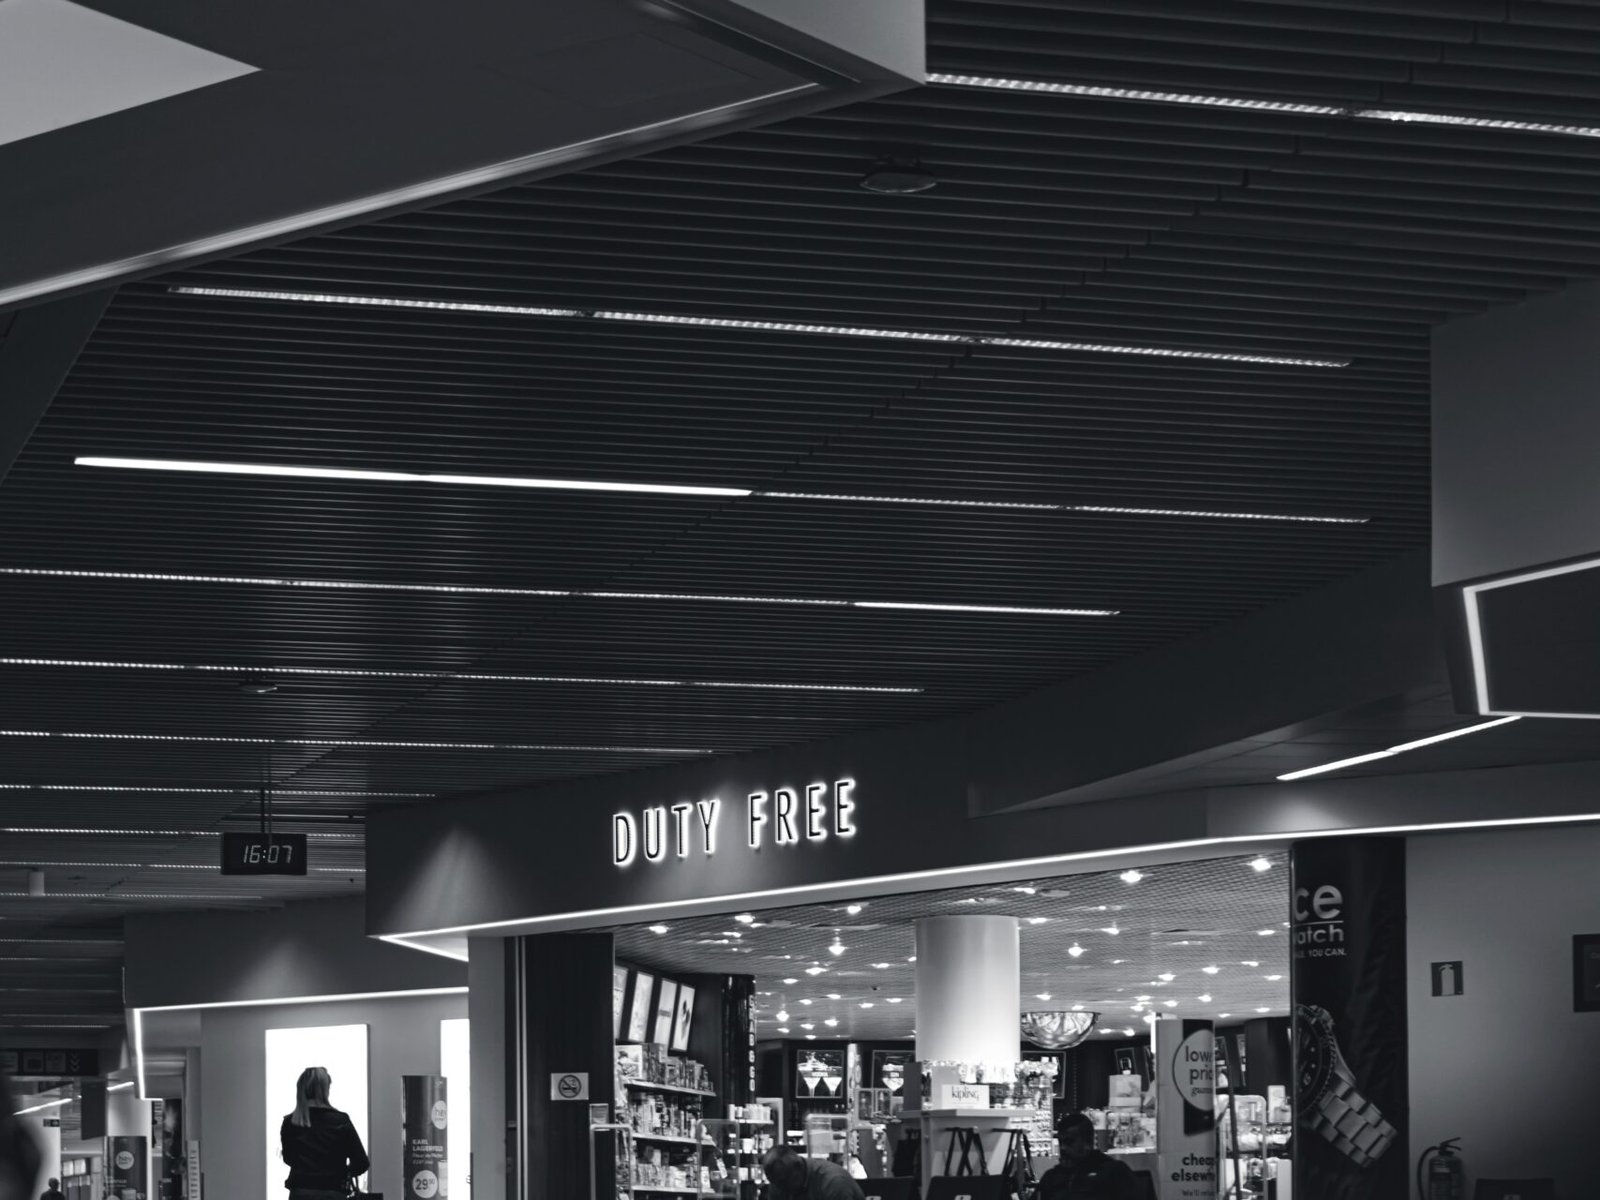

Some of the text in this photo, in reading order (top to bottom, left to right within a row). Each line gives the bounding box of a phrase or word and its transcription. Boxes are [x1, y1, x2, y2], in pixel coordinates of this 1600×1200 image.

[614, 779, 856, 865] DUTY FREE
[243, 845, 293, 864] 16:07
[1295, 884, 1343, 921] ce
[1295, 924, 1345, 944] atch
